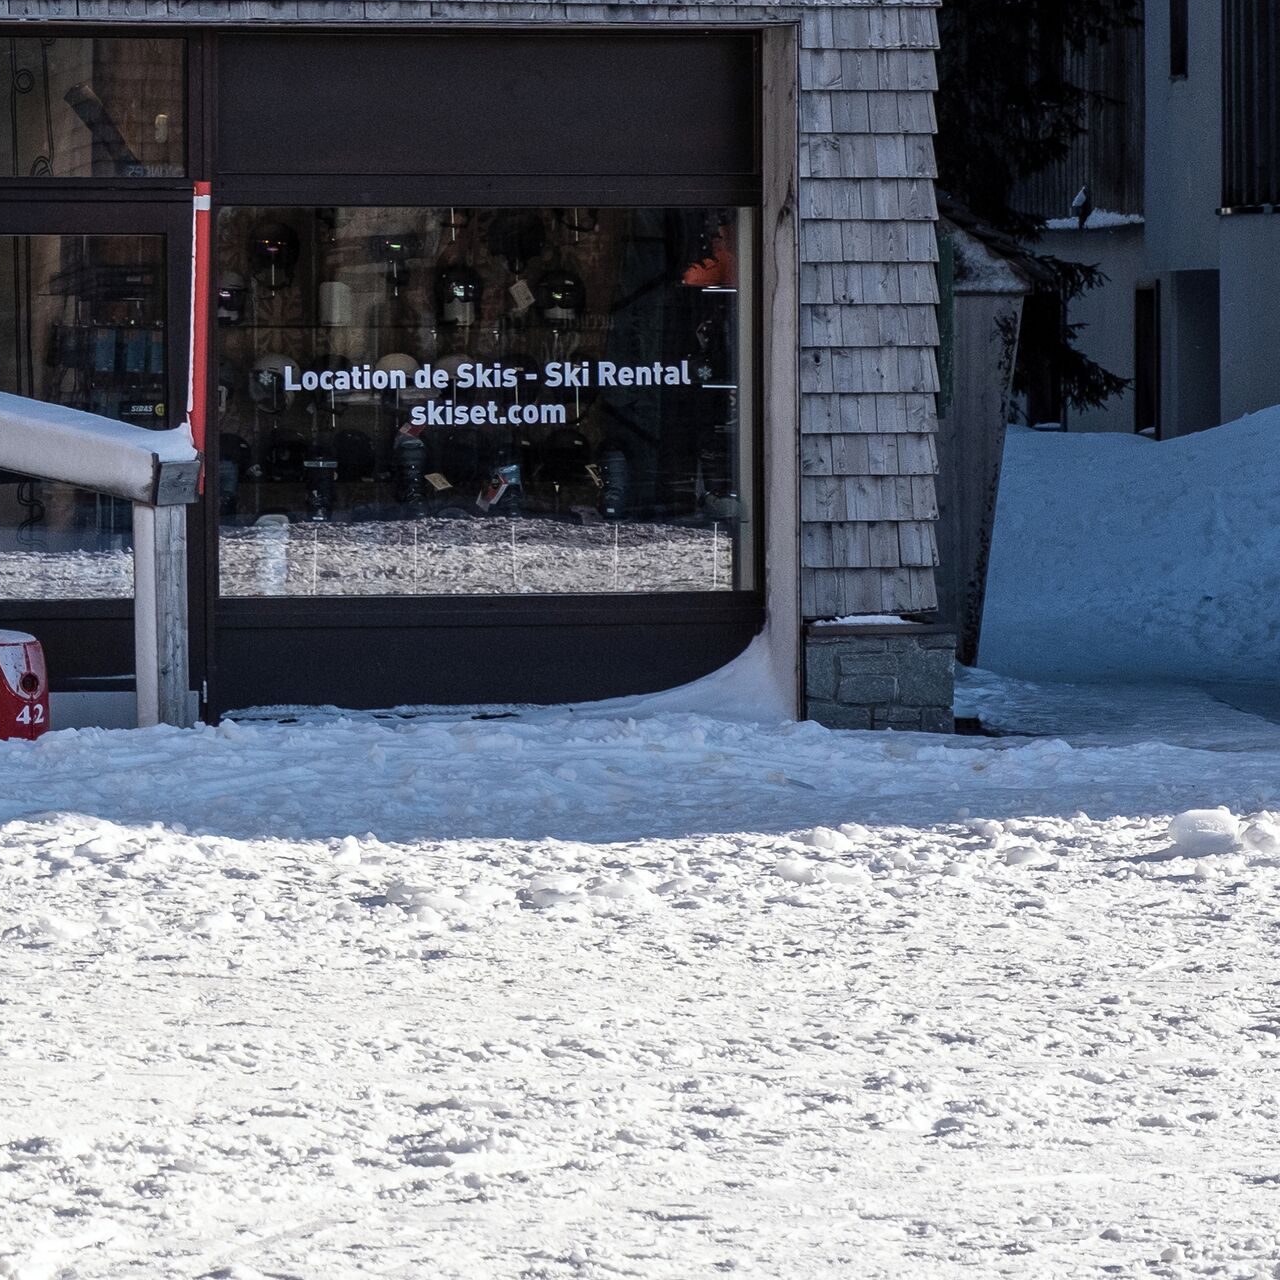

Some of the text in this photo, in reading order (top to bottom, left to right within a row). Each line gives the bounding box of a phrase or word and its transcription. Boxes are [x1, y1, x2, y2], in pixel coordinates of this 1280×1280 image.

[284, 364, 406, 391] Location
[414, 363, 449, 389] de
[456, 362, 518, 388] Skis
[544, 361, 589, 387] Ski
[598, 360, 692, 386] Rental
[411, 400, 566, 426] skiset.com
[15, 703, 45, 725] 42
